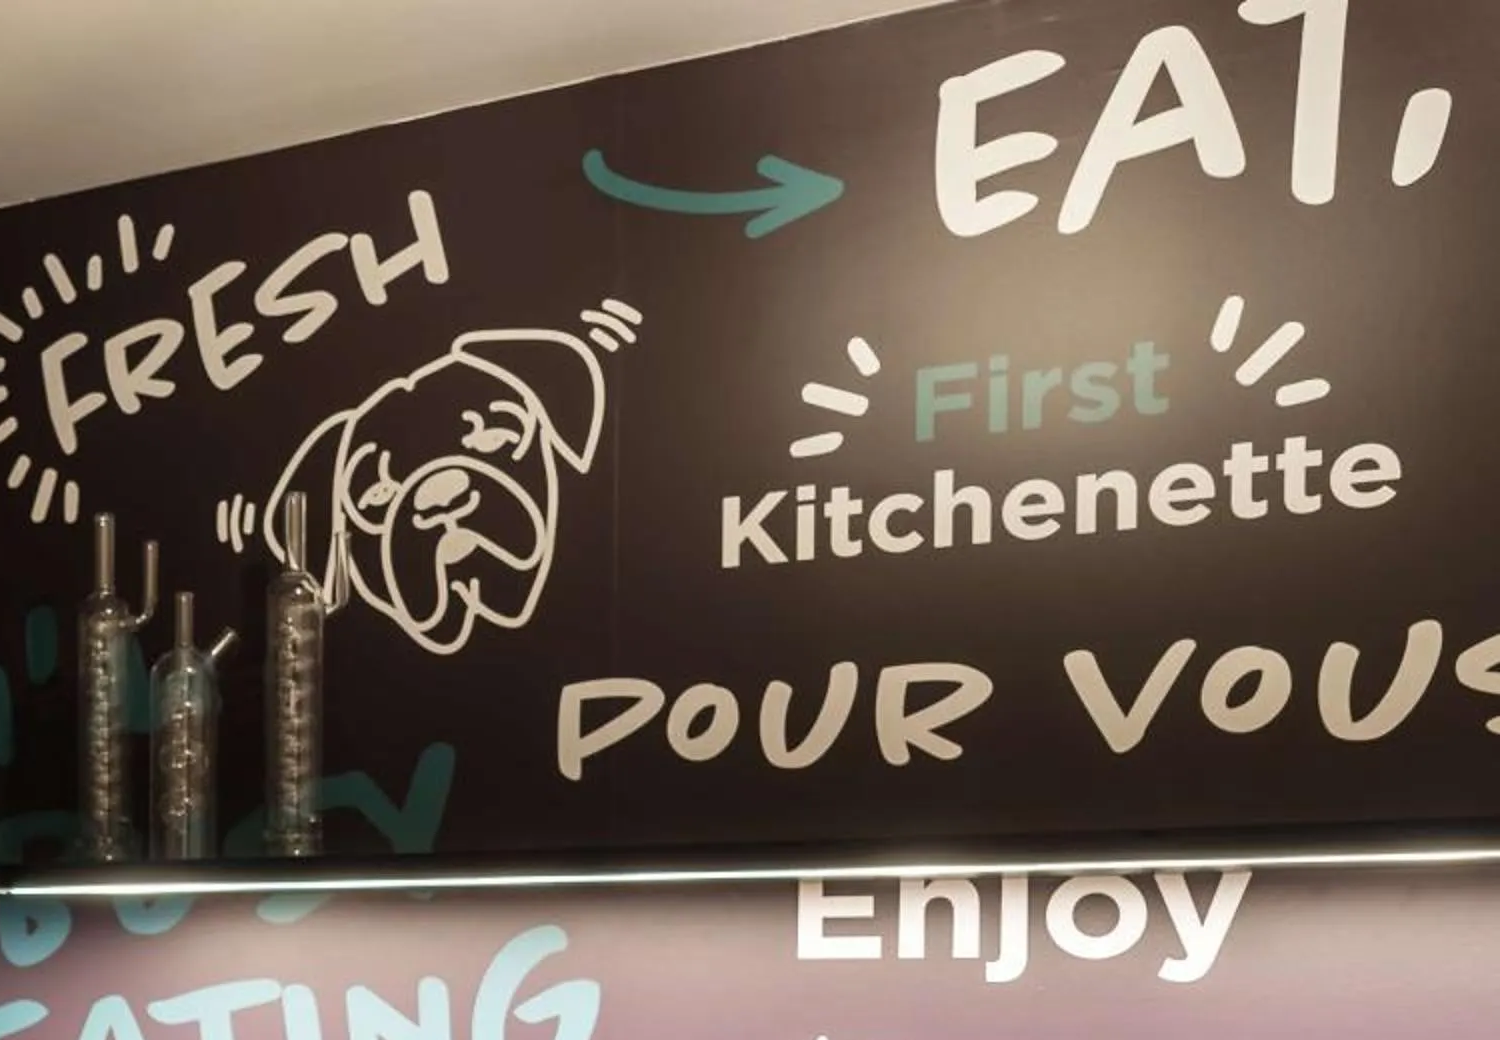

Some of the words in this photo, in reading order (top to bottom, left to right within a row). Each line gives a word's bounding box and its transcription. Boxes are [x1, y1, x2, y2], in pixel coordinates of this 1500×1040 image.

[41, 190, 450, 455] FRESH
[914, 341, 1172, 442] First
[719, 435, 1403, 568] Kitchenette
[557, 660, 994, 781] POUR
[796, 868, 1254, 984] Enjoy
